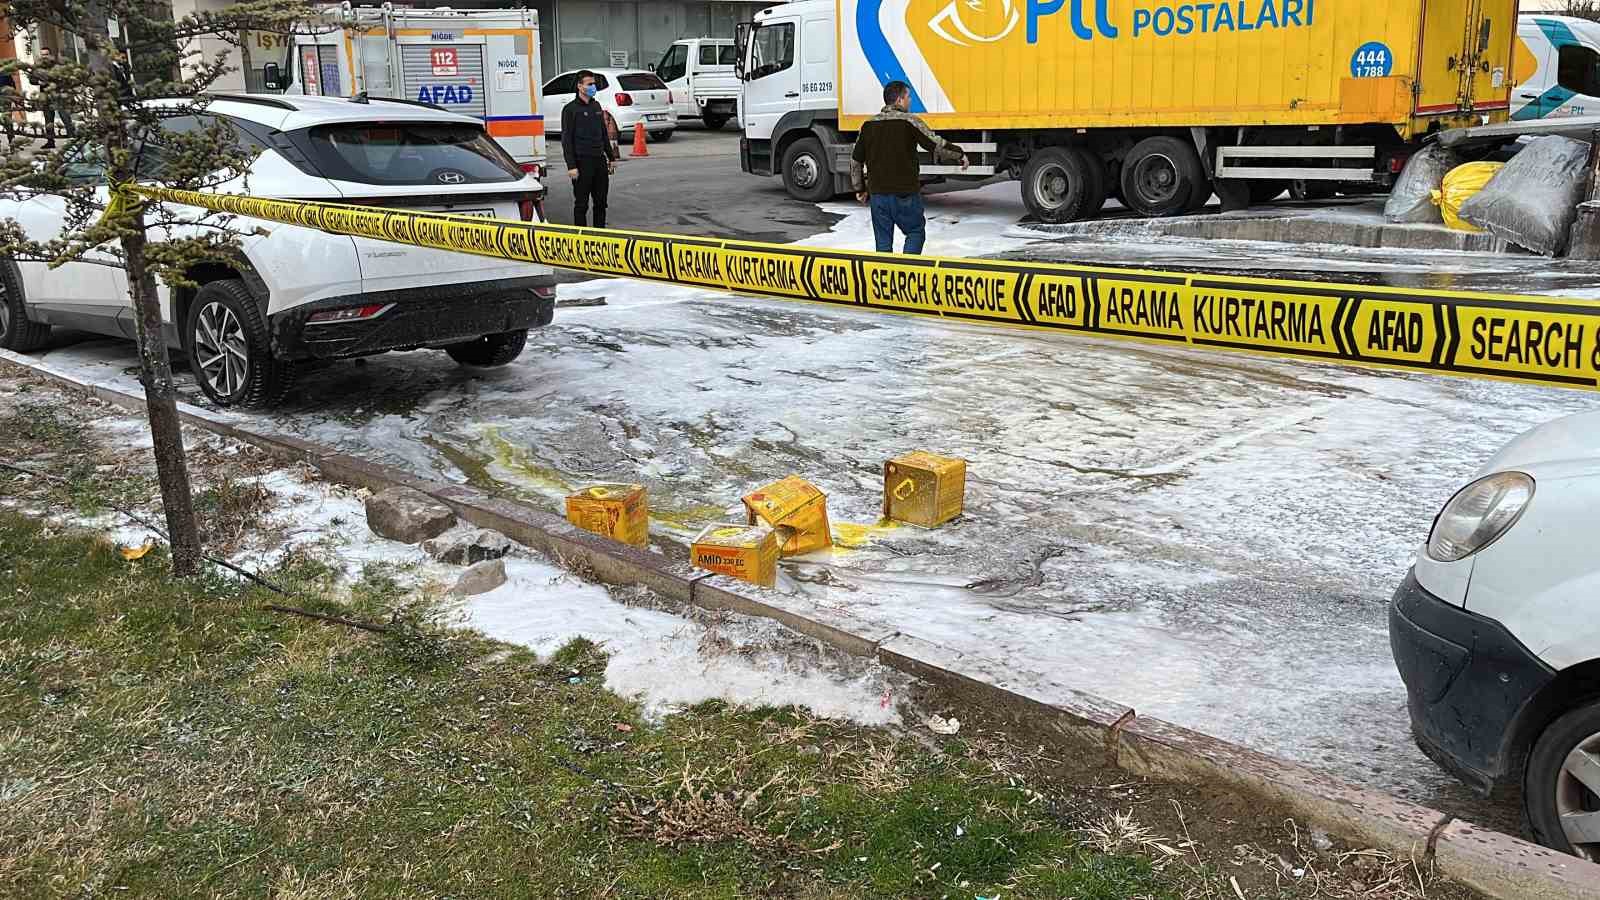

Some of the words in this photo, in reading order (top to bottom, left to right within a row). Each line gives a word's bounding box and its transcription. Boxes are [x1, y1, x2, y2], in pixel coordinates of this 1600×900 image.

[1132, 0, 1315, 38] POSTALARI
[434, 52, 454, 65] 112
[1357, 50, 1386, 65] 444
[418, 85, 473, 104] AFAD
[418, 222, 446, 243] ARAMA
[449, 225, 496, 251] KURTARMA
[508, 232, 526, 257] AFAD
[539, 236, 576, 261] SEARCH
[576, 242, 585, 264] &
[585, 241, 624, 269] RESCUE
[639, 246, 661, 273] AFAD
[678, 250, 722, 281] ARAMA
[725, 254, 800, 291] KURTARMA
[819, 263, 849, 296] AFAD
[872, 268, 927, 304] SEARCH
[931, 274, 943, 306] &
[944, 274, 1008, 312] RESCUE
[1038, 283, 1076, 319] AFAD
[1106, 287, 1184, 330] ARAMA
[1193, 294, 1326, 345] KURTARMA
[1367, 309, 1424, 354] AFAD
[1470, 316, 1584, 370] SEARCH
